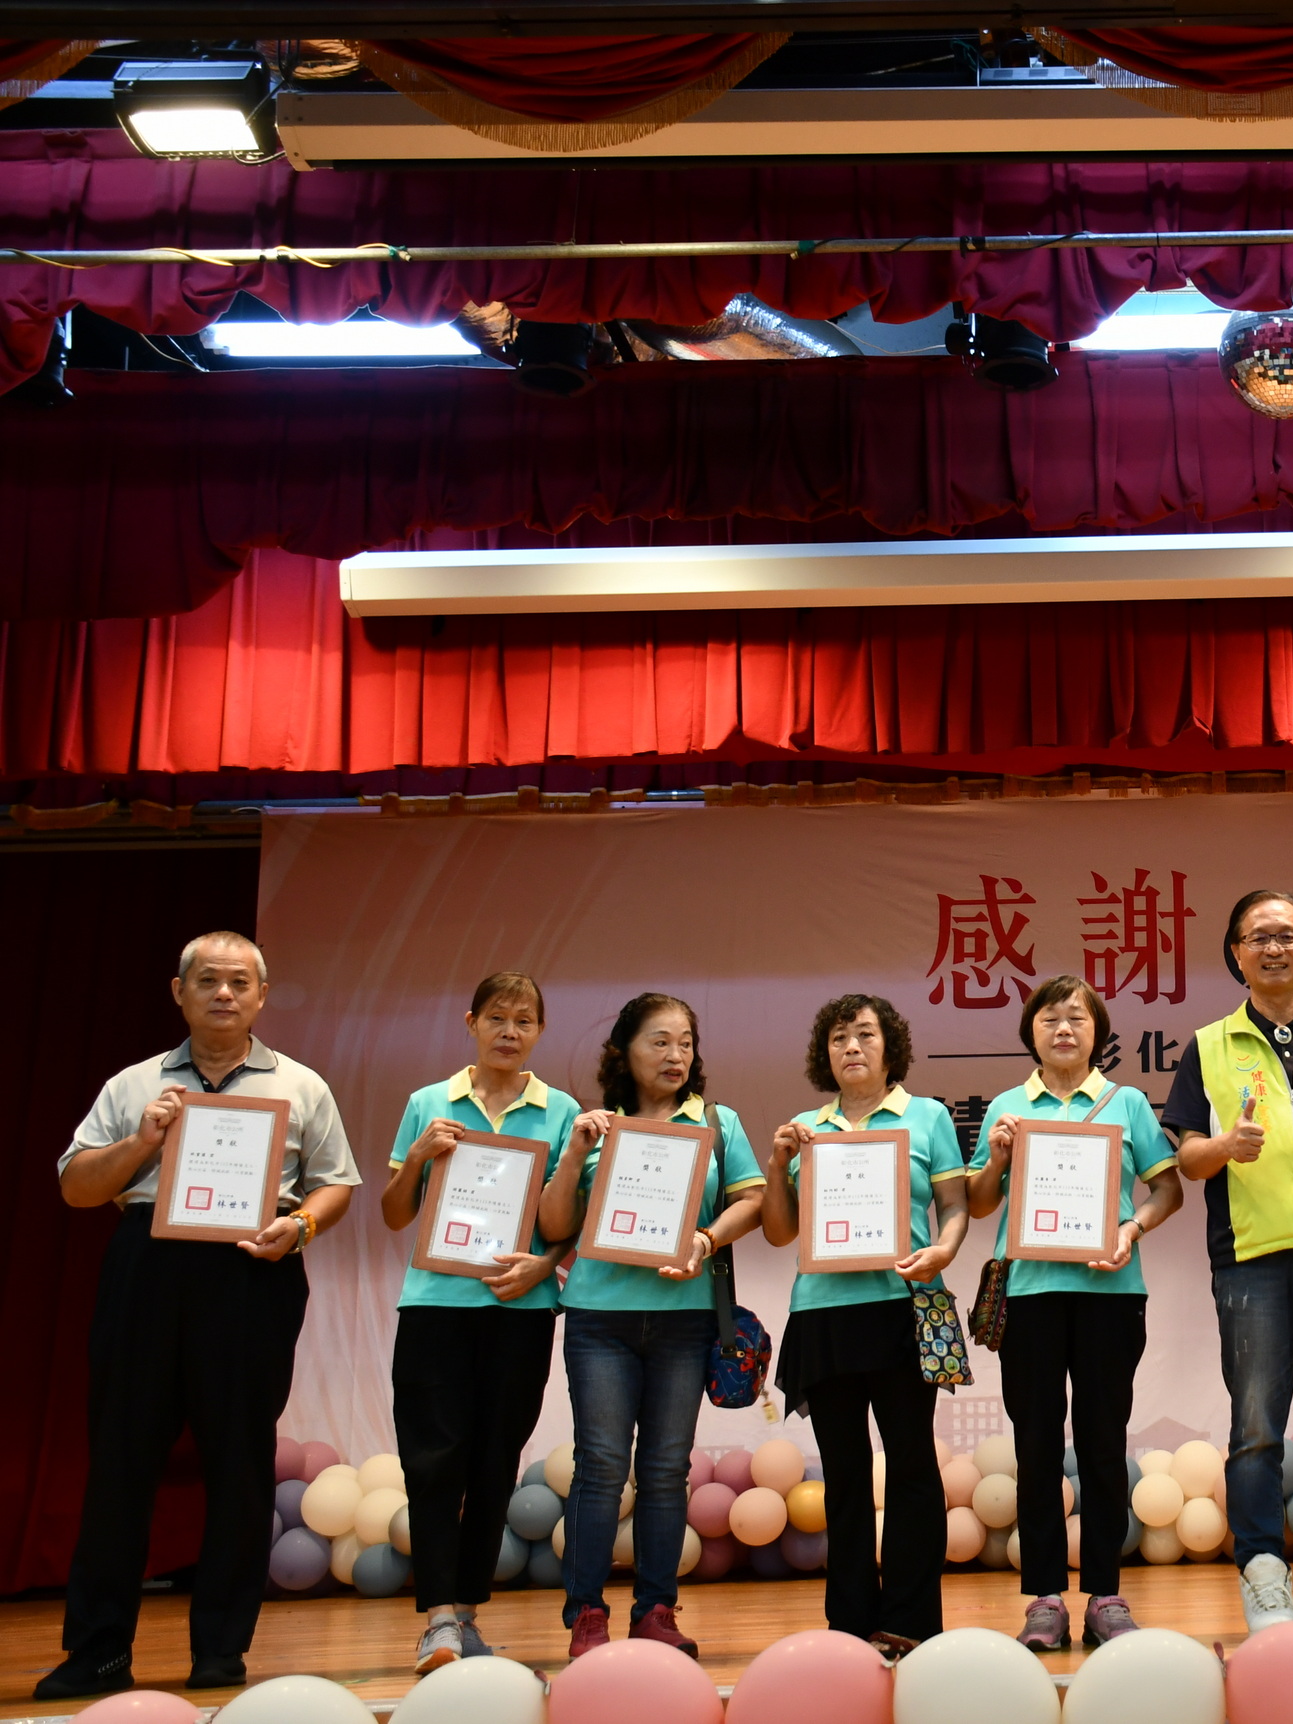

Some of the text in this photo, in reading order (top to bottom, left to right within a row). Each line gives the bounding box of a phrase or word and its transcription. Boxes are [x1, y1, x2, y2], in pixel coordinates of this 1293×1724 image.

[926, 868, 1197, 1009] 感謝
[217, 1200, 249, 1209] 林世賢
[639, 1225, 668, 1236] 林世賢
[1064, 1222, 1092, 1231] 林世賢
[855, 1229, 883, 1238] 林世賢
